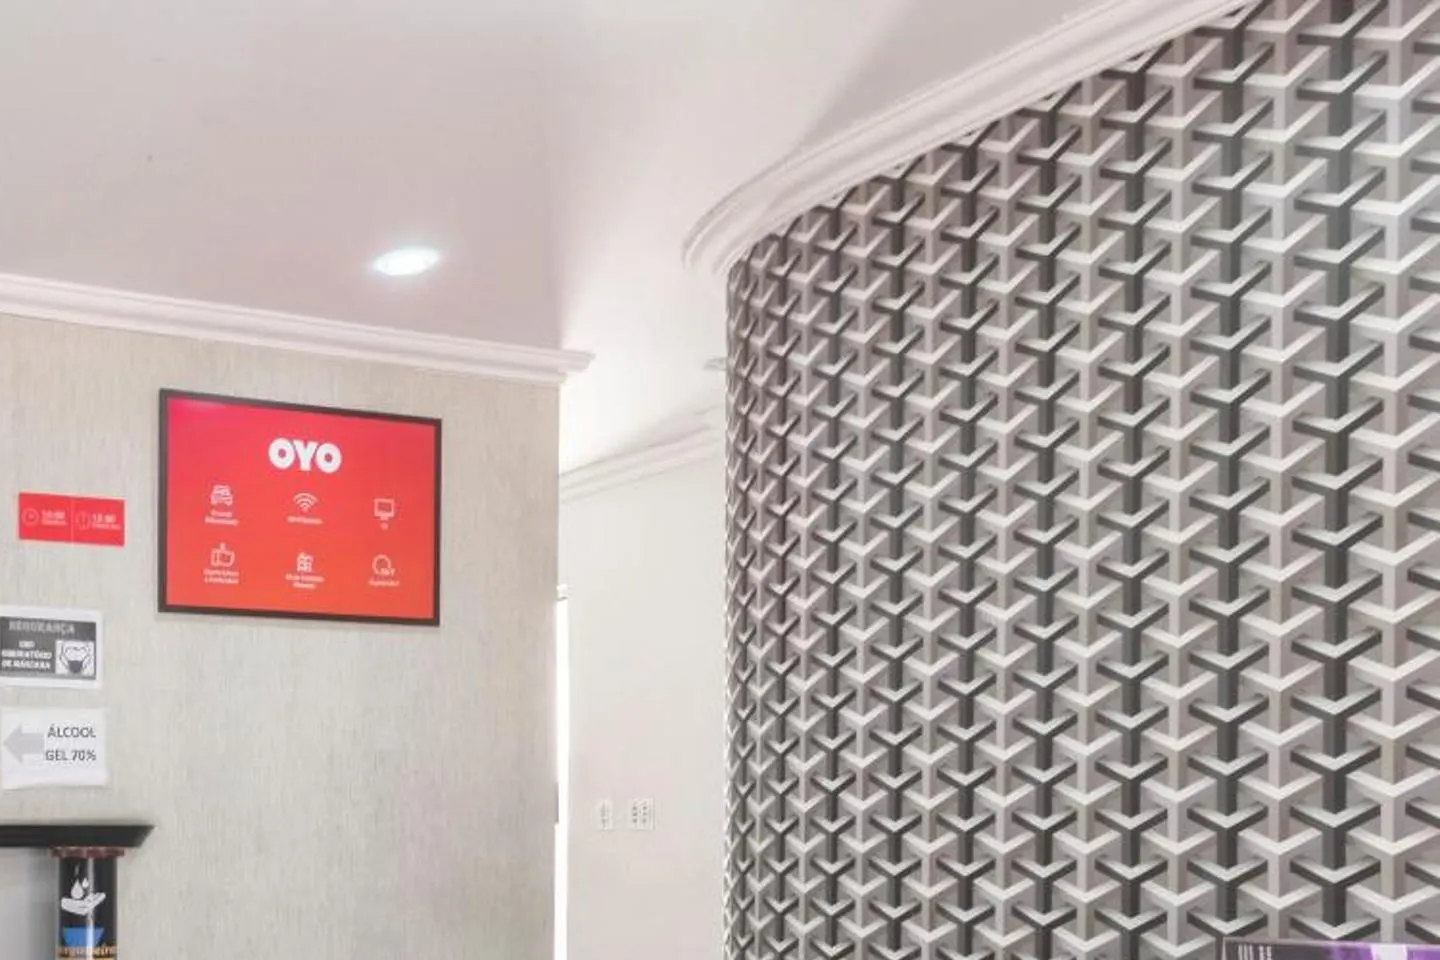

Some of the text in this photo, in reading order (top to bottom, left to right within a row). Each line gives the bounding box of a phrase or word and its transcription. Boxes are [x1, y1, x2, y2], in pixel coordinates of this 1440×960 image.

[268, 437, 342, 473] OYO
[48, 724, 96, 738] ÁLCOOL
[45, 750, 96, 761] GEL 70%
